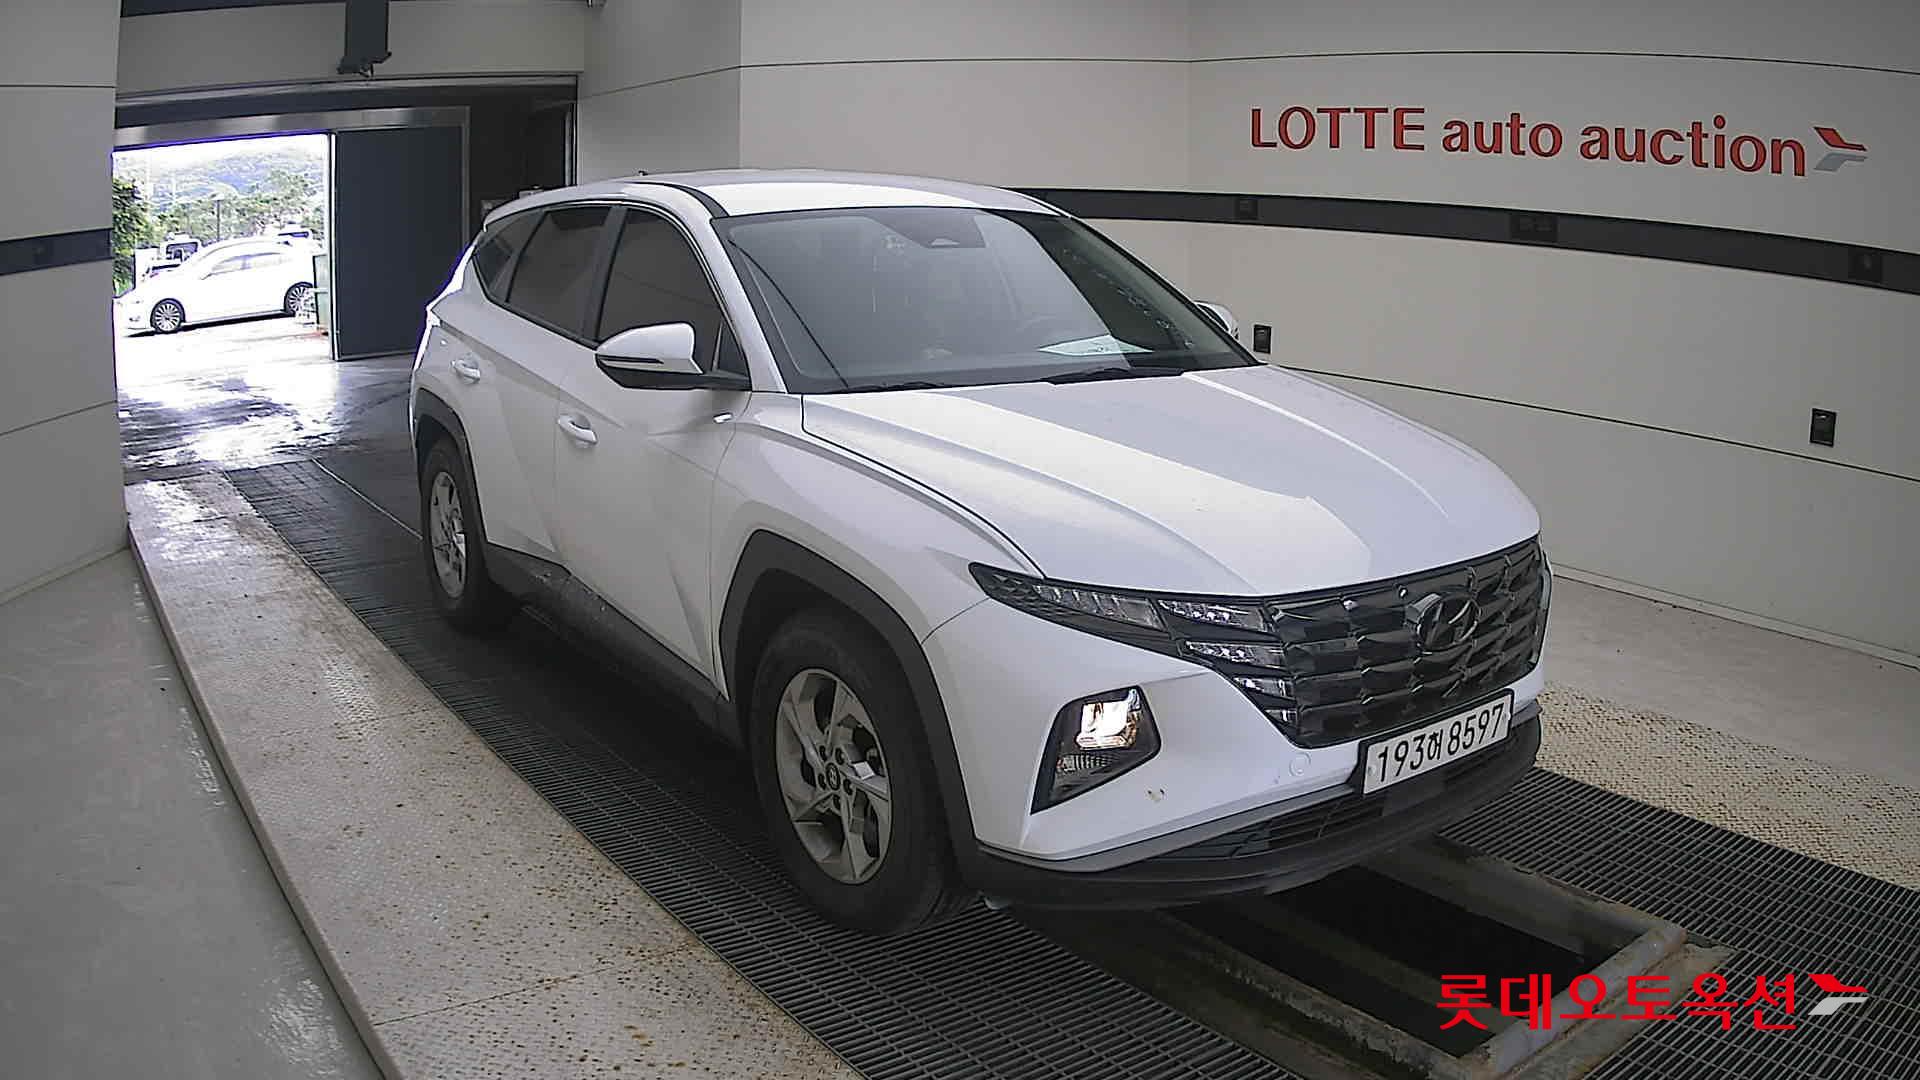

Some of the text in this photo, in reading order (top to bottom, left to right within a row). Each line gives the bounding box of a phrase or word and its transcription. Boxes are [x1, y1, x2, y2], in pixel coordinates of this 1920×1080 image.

[1250, 106, 1806, 176] LOTTE auto auction
[1377, 702, 1505, 783] 193허 8597
